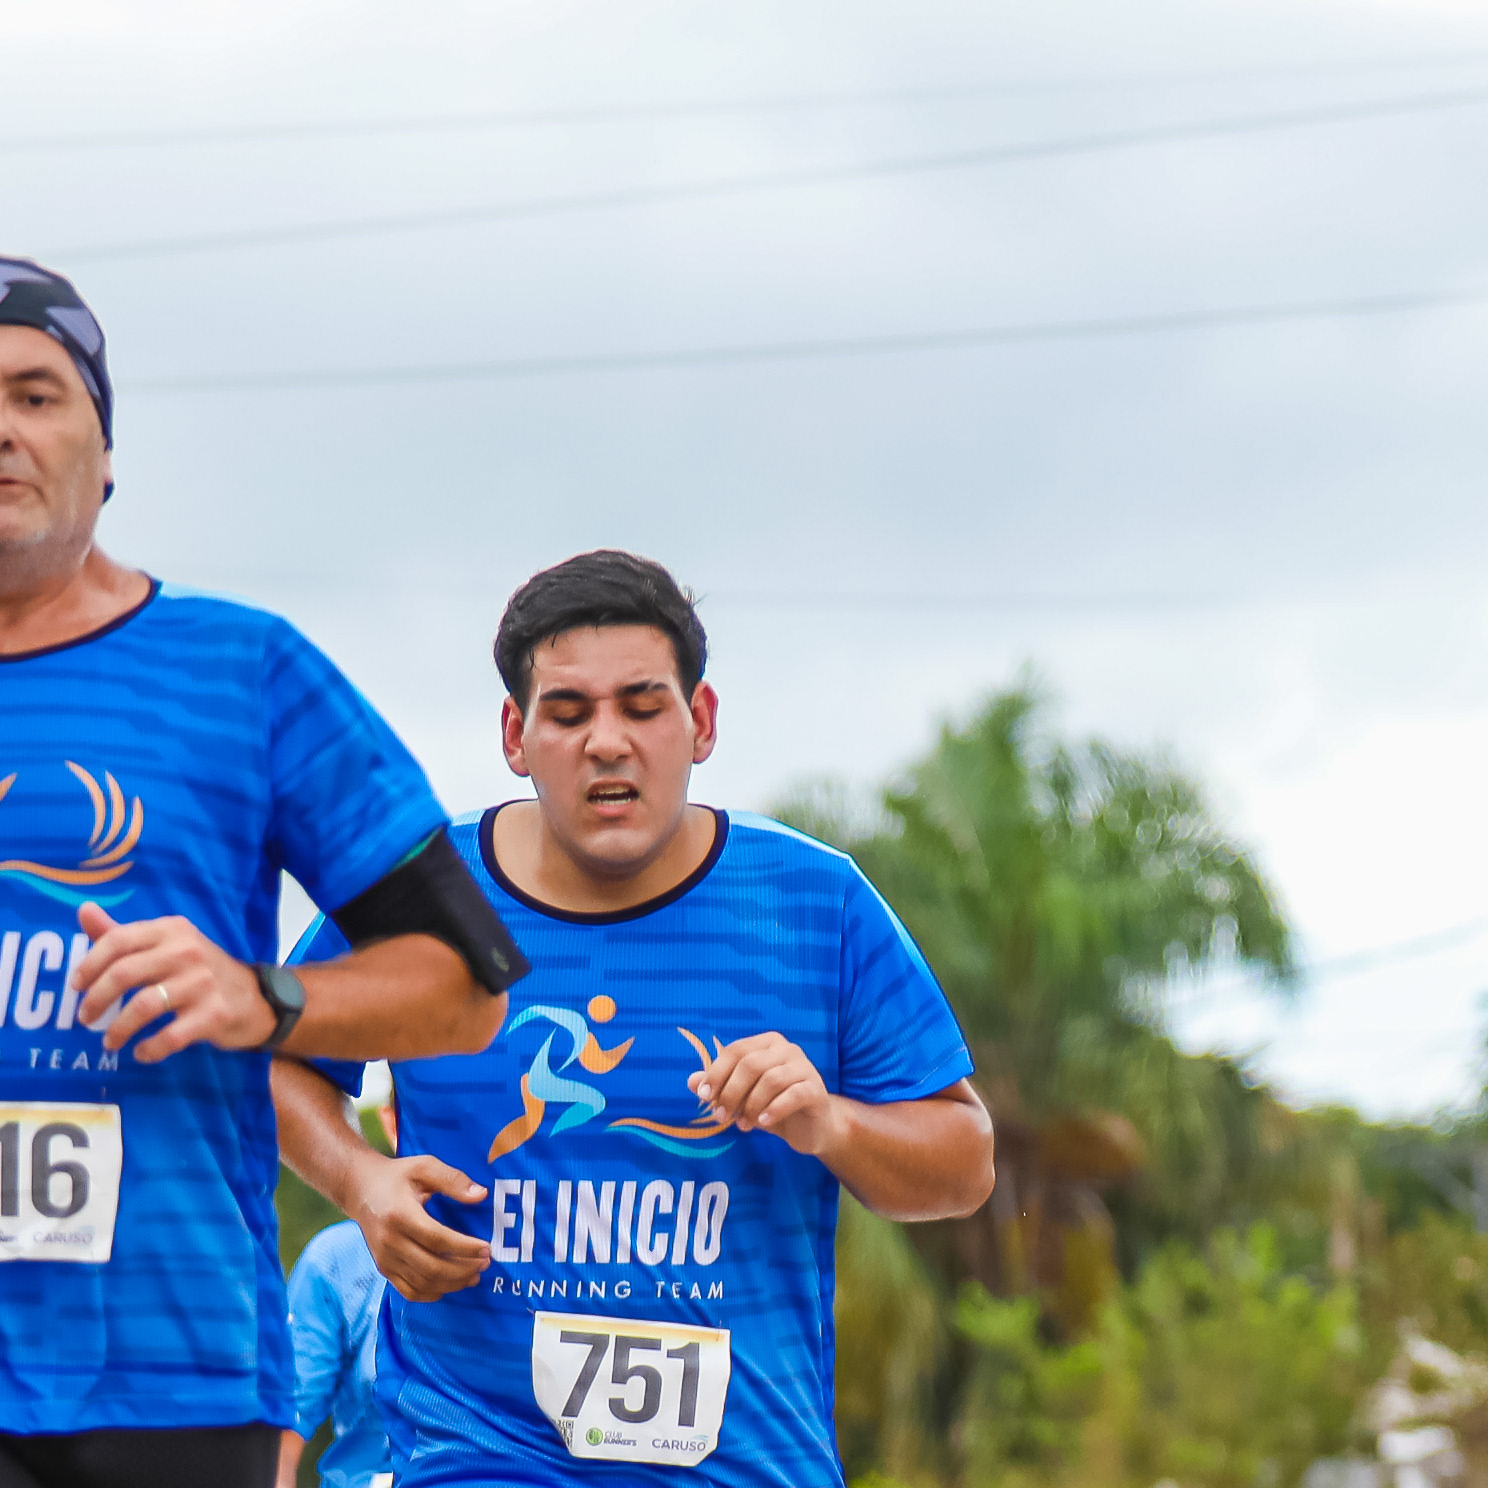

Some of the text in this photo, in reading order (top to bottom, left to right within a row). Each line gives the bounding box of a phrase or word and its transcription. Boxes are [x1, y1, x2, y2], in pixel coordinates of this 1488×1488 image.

[29, 1047, 119, 1072] TEAM
[554, 1179, 729, 1267] INICIO
[493, 1276, 724, 1300] RUNNING TEAM
[559, 1330, 700, 1428] 751
[651, 1438, 707, 1452] CARUSO
